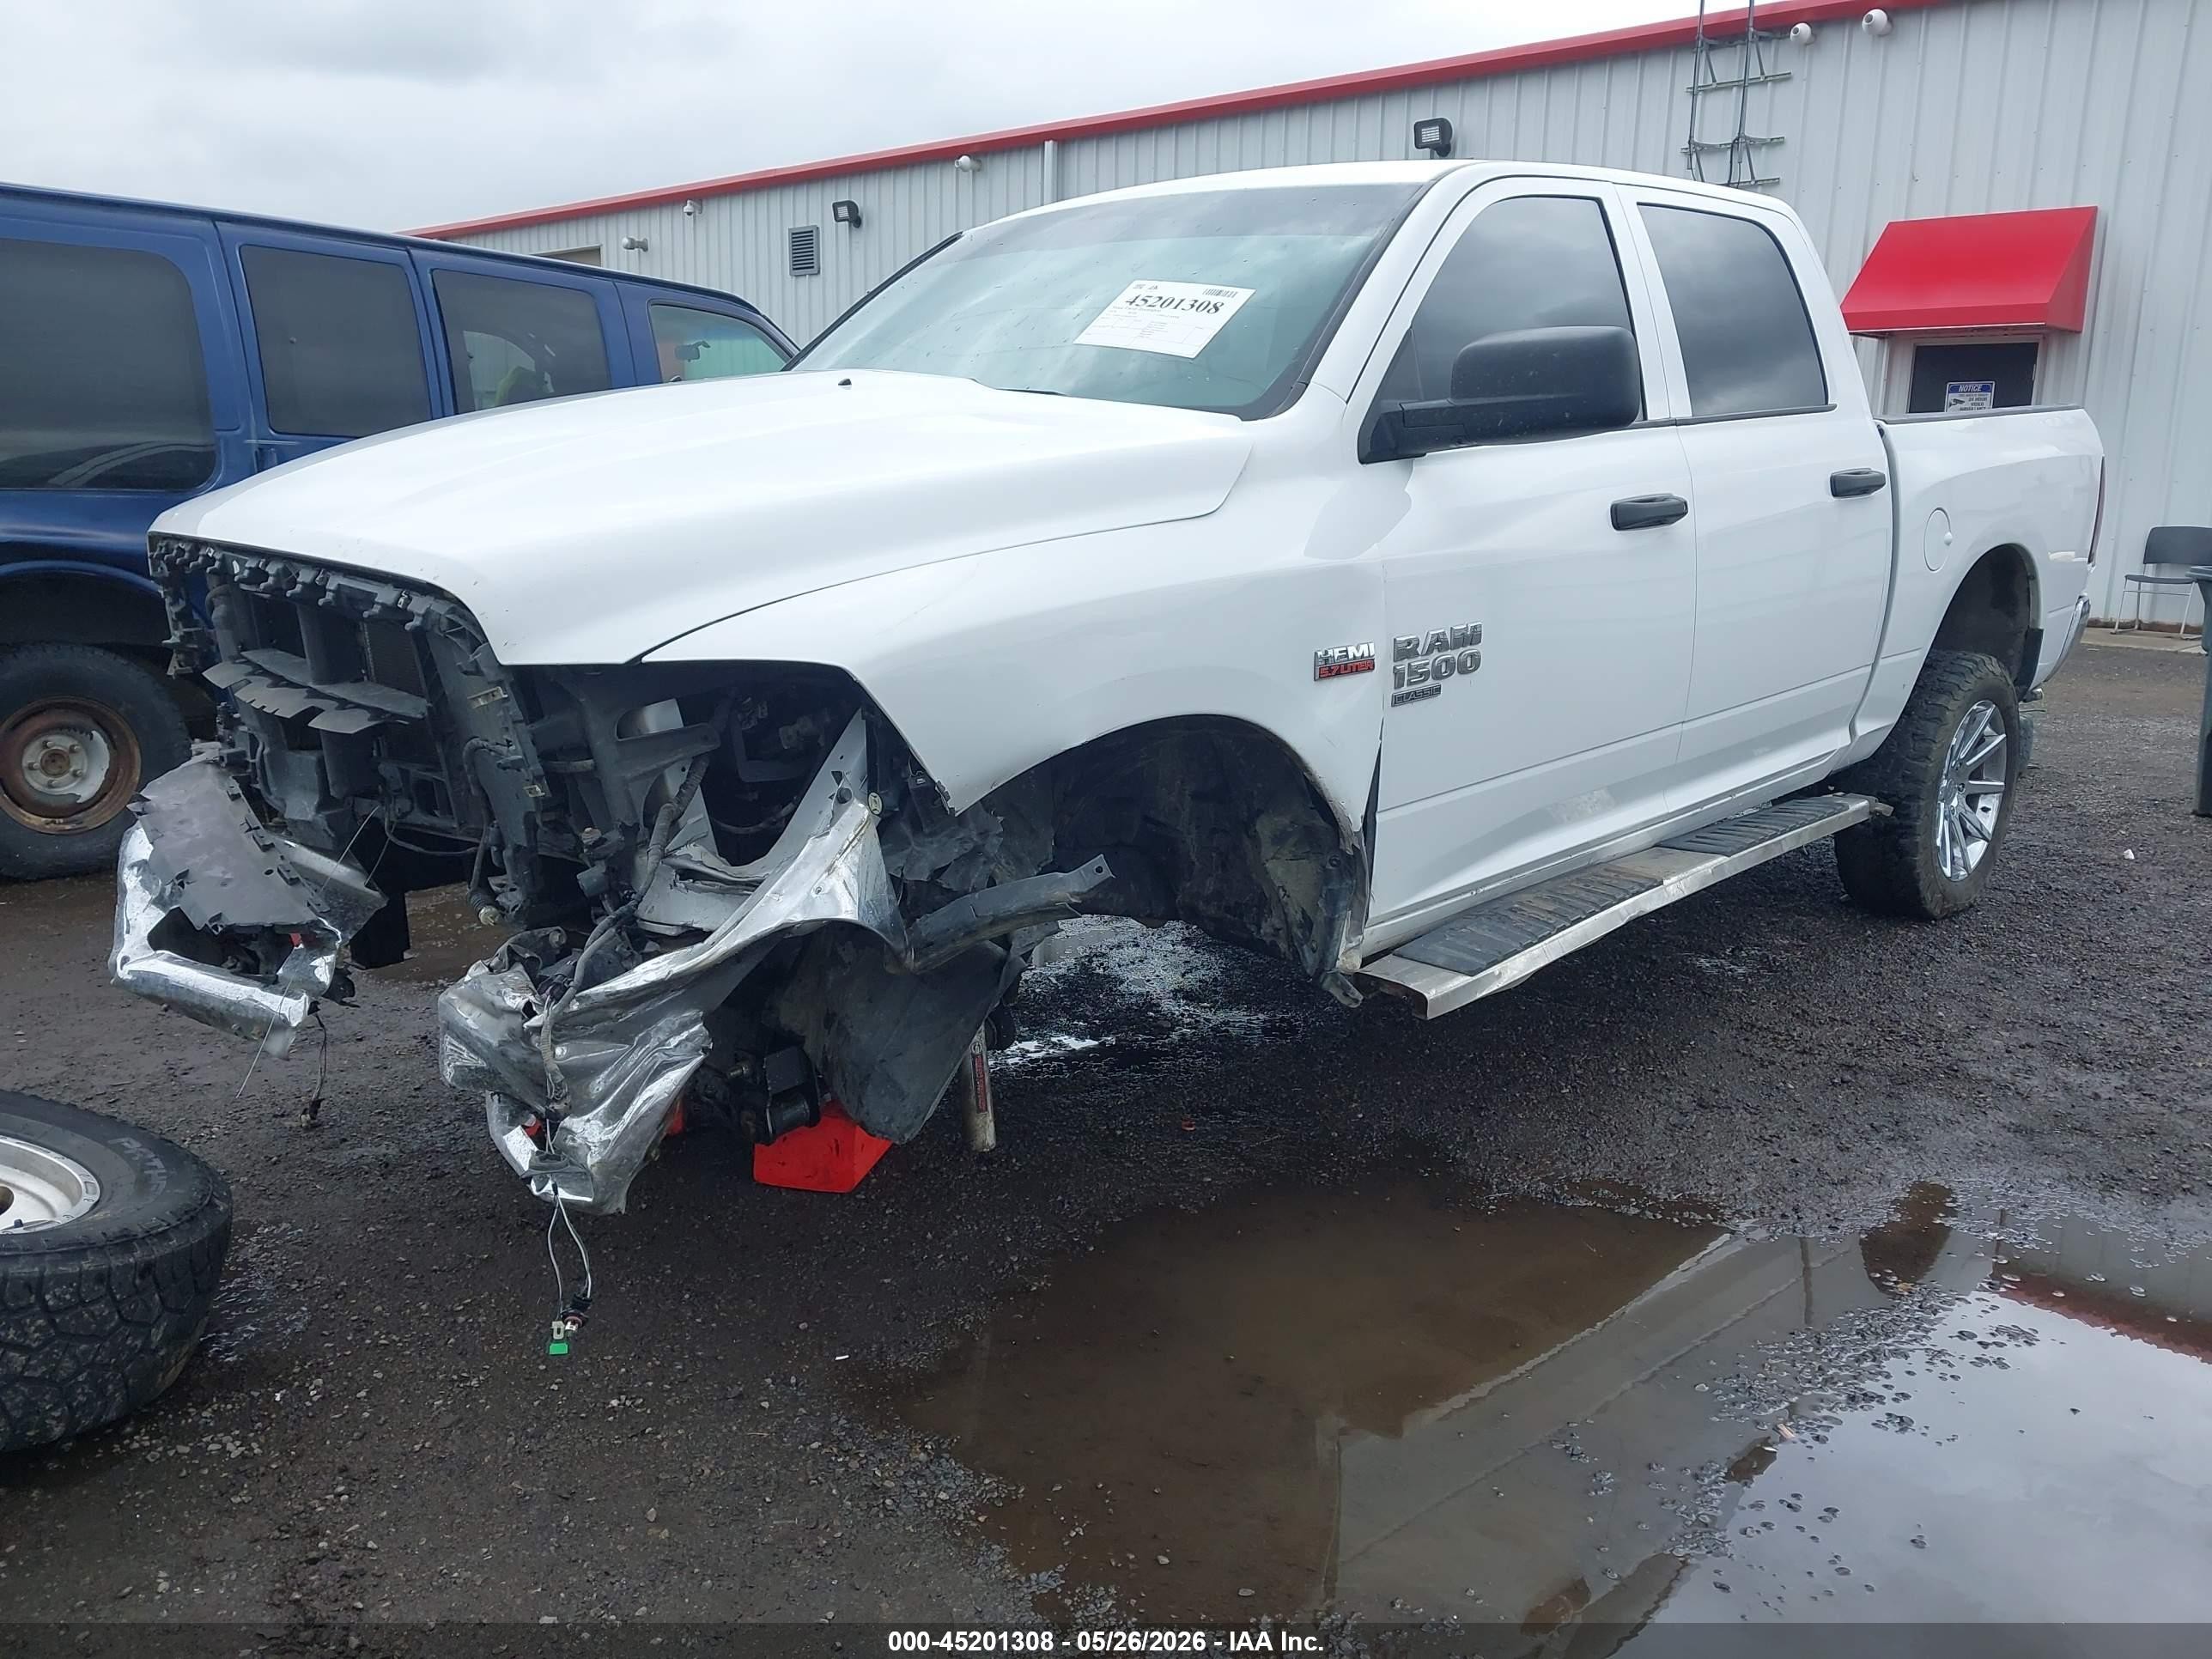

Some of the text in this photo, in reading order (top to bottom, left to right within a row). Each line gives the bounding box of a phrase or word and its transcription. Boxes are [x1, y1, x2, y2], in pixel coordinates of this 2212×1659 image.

[1125, 294, 1224, 315] 45201308
[1393, 621, 1483, 663] RAM
[1316, 642, 1375, 665] HEMI
[1319, 659, 1374, 678] 5.7 LITER
[1393, 648, 1482, 690] 1500
[1395, 685, 1442, 703] CLASSIC
